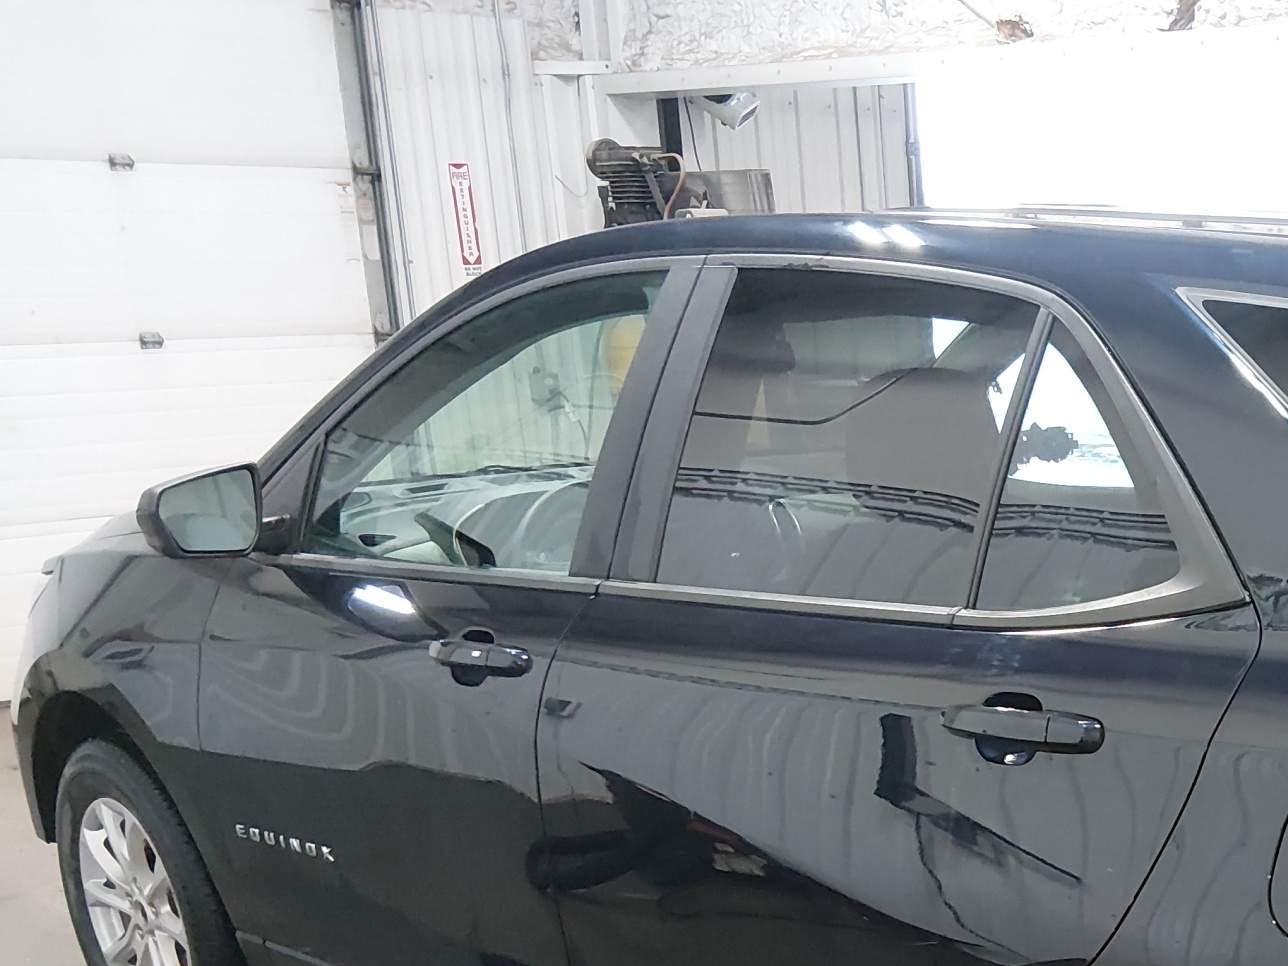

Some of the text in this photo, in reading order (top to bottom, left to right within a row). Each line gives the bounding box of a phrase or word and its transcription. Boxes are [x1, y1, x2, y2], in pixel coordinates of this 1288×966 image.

[452, 171, 469, 180] FIRE
[459, 181, 474, 257] EXTINGUISHER
[235, 823, 335, 862] EQUINOX
